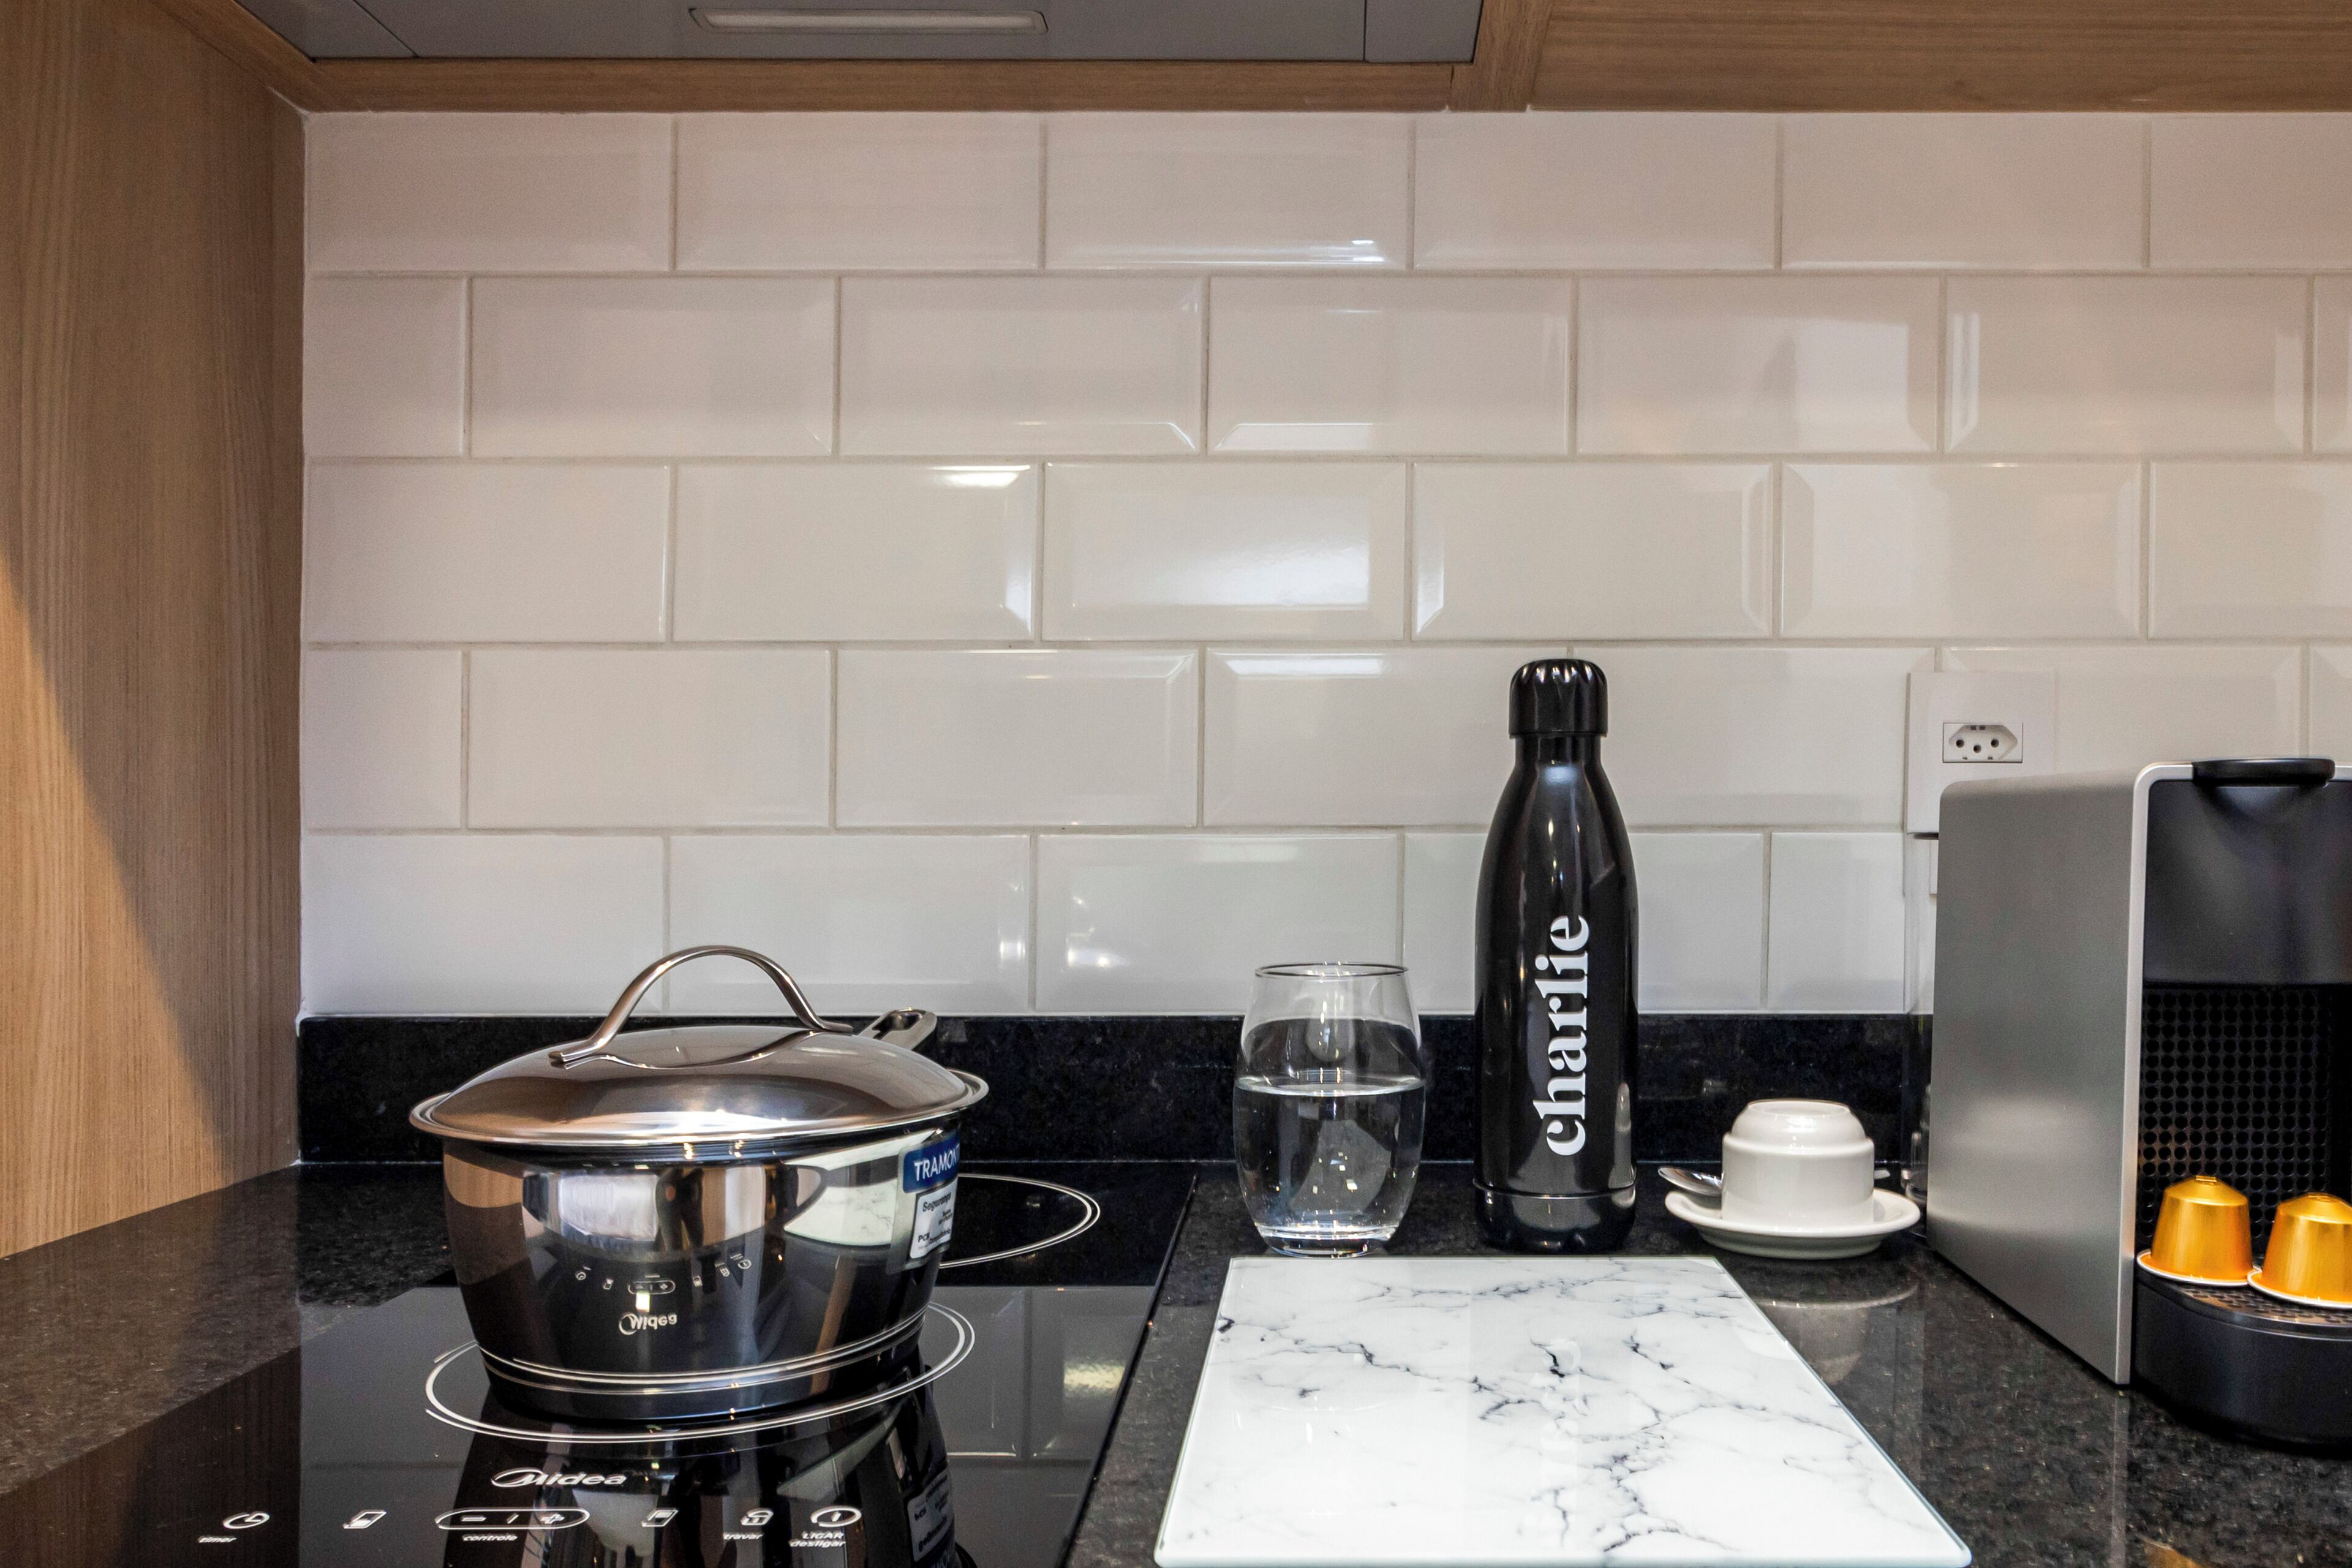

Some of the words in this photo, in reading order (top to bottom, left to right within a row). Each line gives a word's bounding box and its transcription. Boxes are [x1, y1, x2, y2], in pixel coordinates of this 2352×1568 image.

[1532, 915, 1590, 1156] charlie
[491, 1468, 627, 1487] Midea
[790, 1539, 846, 1548] desligar
